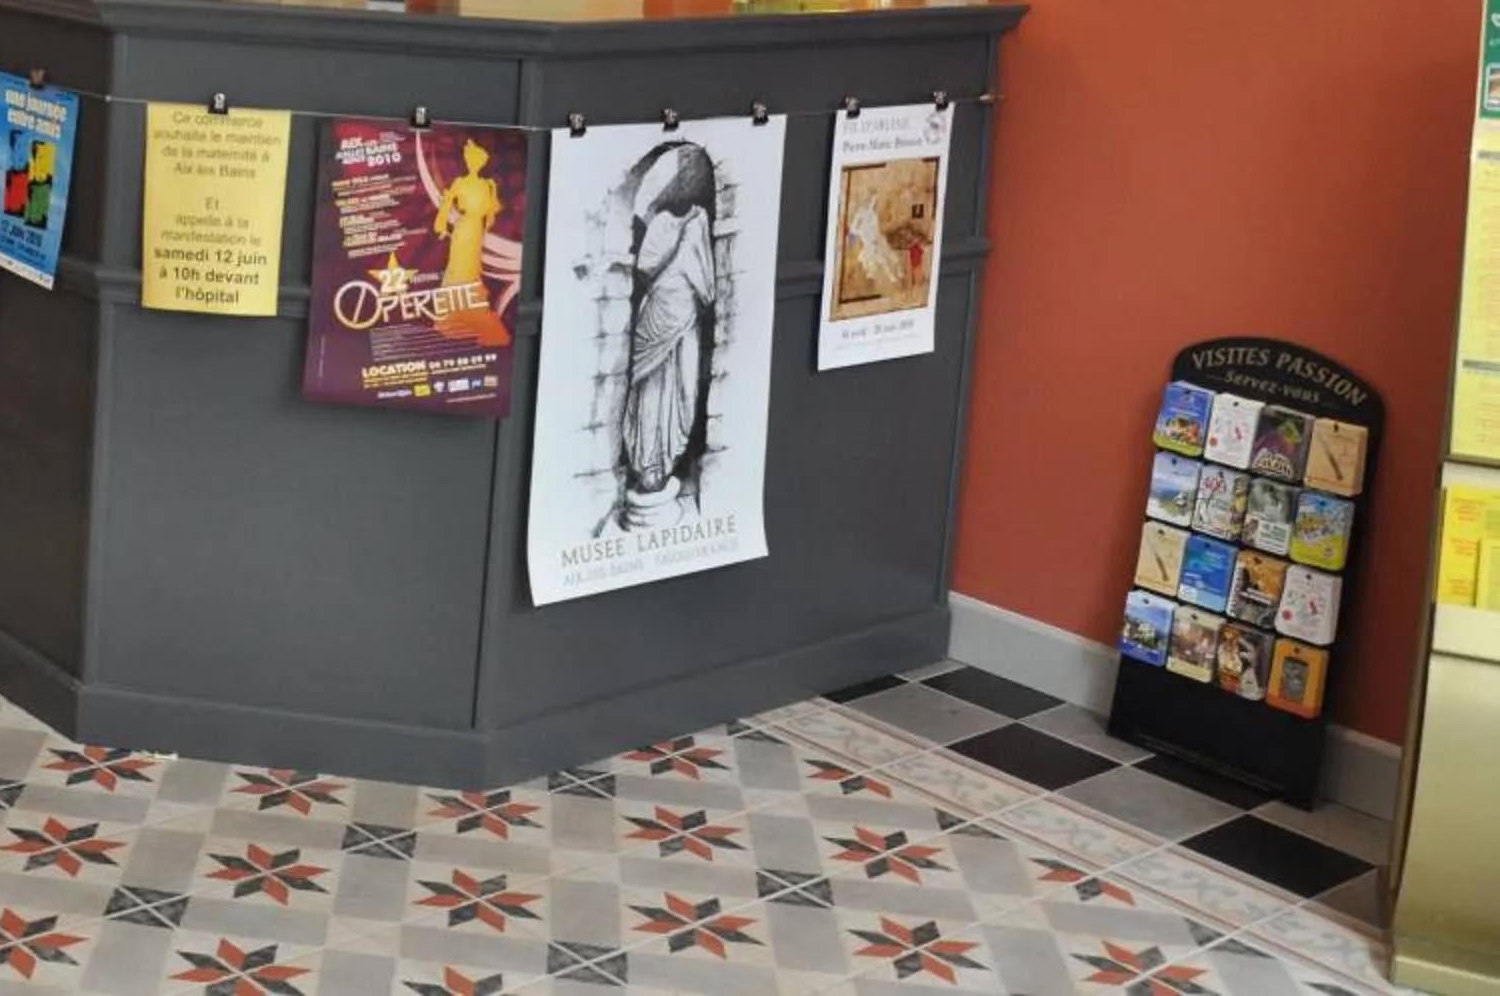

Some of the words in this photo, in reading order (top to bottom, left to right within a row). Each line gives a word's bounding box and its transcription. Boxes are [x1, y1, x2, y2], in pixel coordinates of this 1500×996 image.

[171, 110, 192, 125] Ce
[154, 246, 209, 262] samedi
[214, 248, 234, 264] 12
[236, 250, 268, 267] juin
[159, 264, 169, 280] à
[174, 265, 200, 282] 10h
[205, 267, 260, 286] devant
[175, 285, 241, 305] l'hôpital
[361, 359, 428, 379] LOCATION
[1192, 347, 1271, 371] VISITES
[1274, 351, 1369, 405] PASSION
[637, 515, 736, 553] LAPIDAIRE
